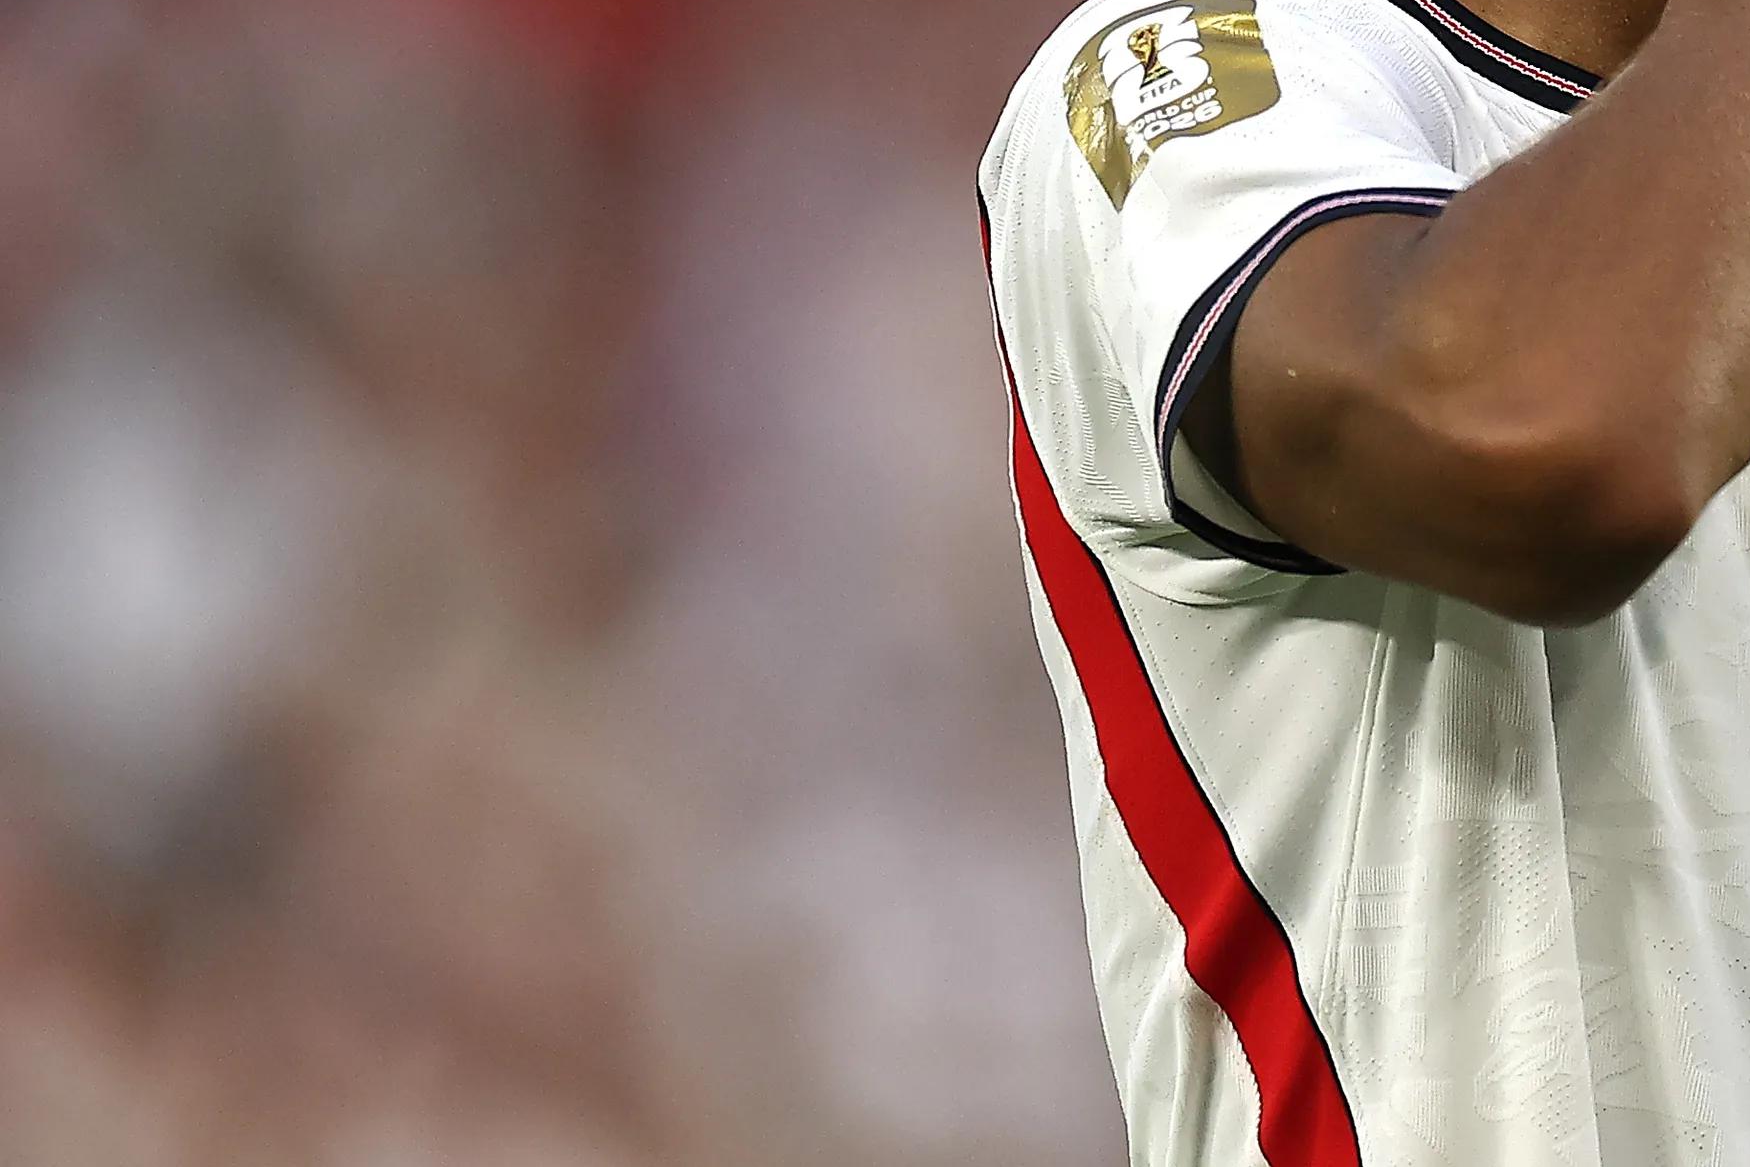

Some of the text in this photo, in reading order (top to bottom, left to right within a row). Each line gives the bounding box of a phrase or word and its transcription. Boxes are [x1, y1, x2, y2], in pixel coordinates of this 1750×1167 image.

[1139, 78, 1182, 103] FIFA
[1127, 87, 1217, 134] ORLD CUP
